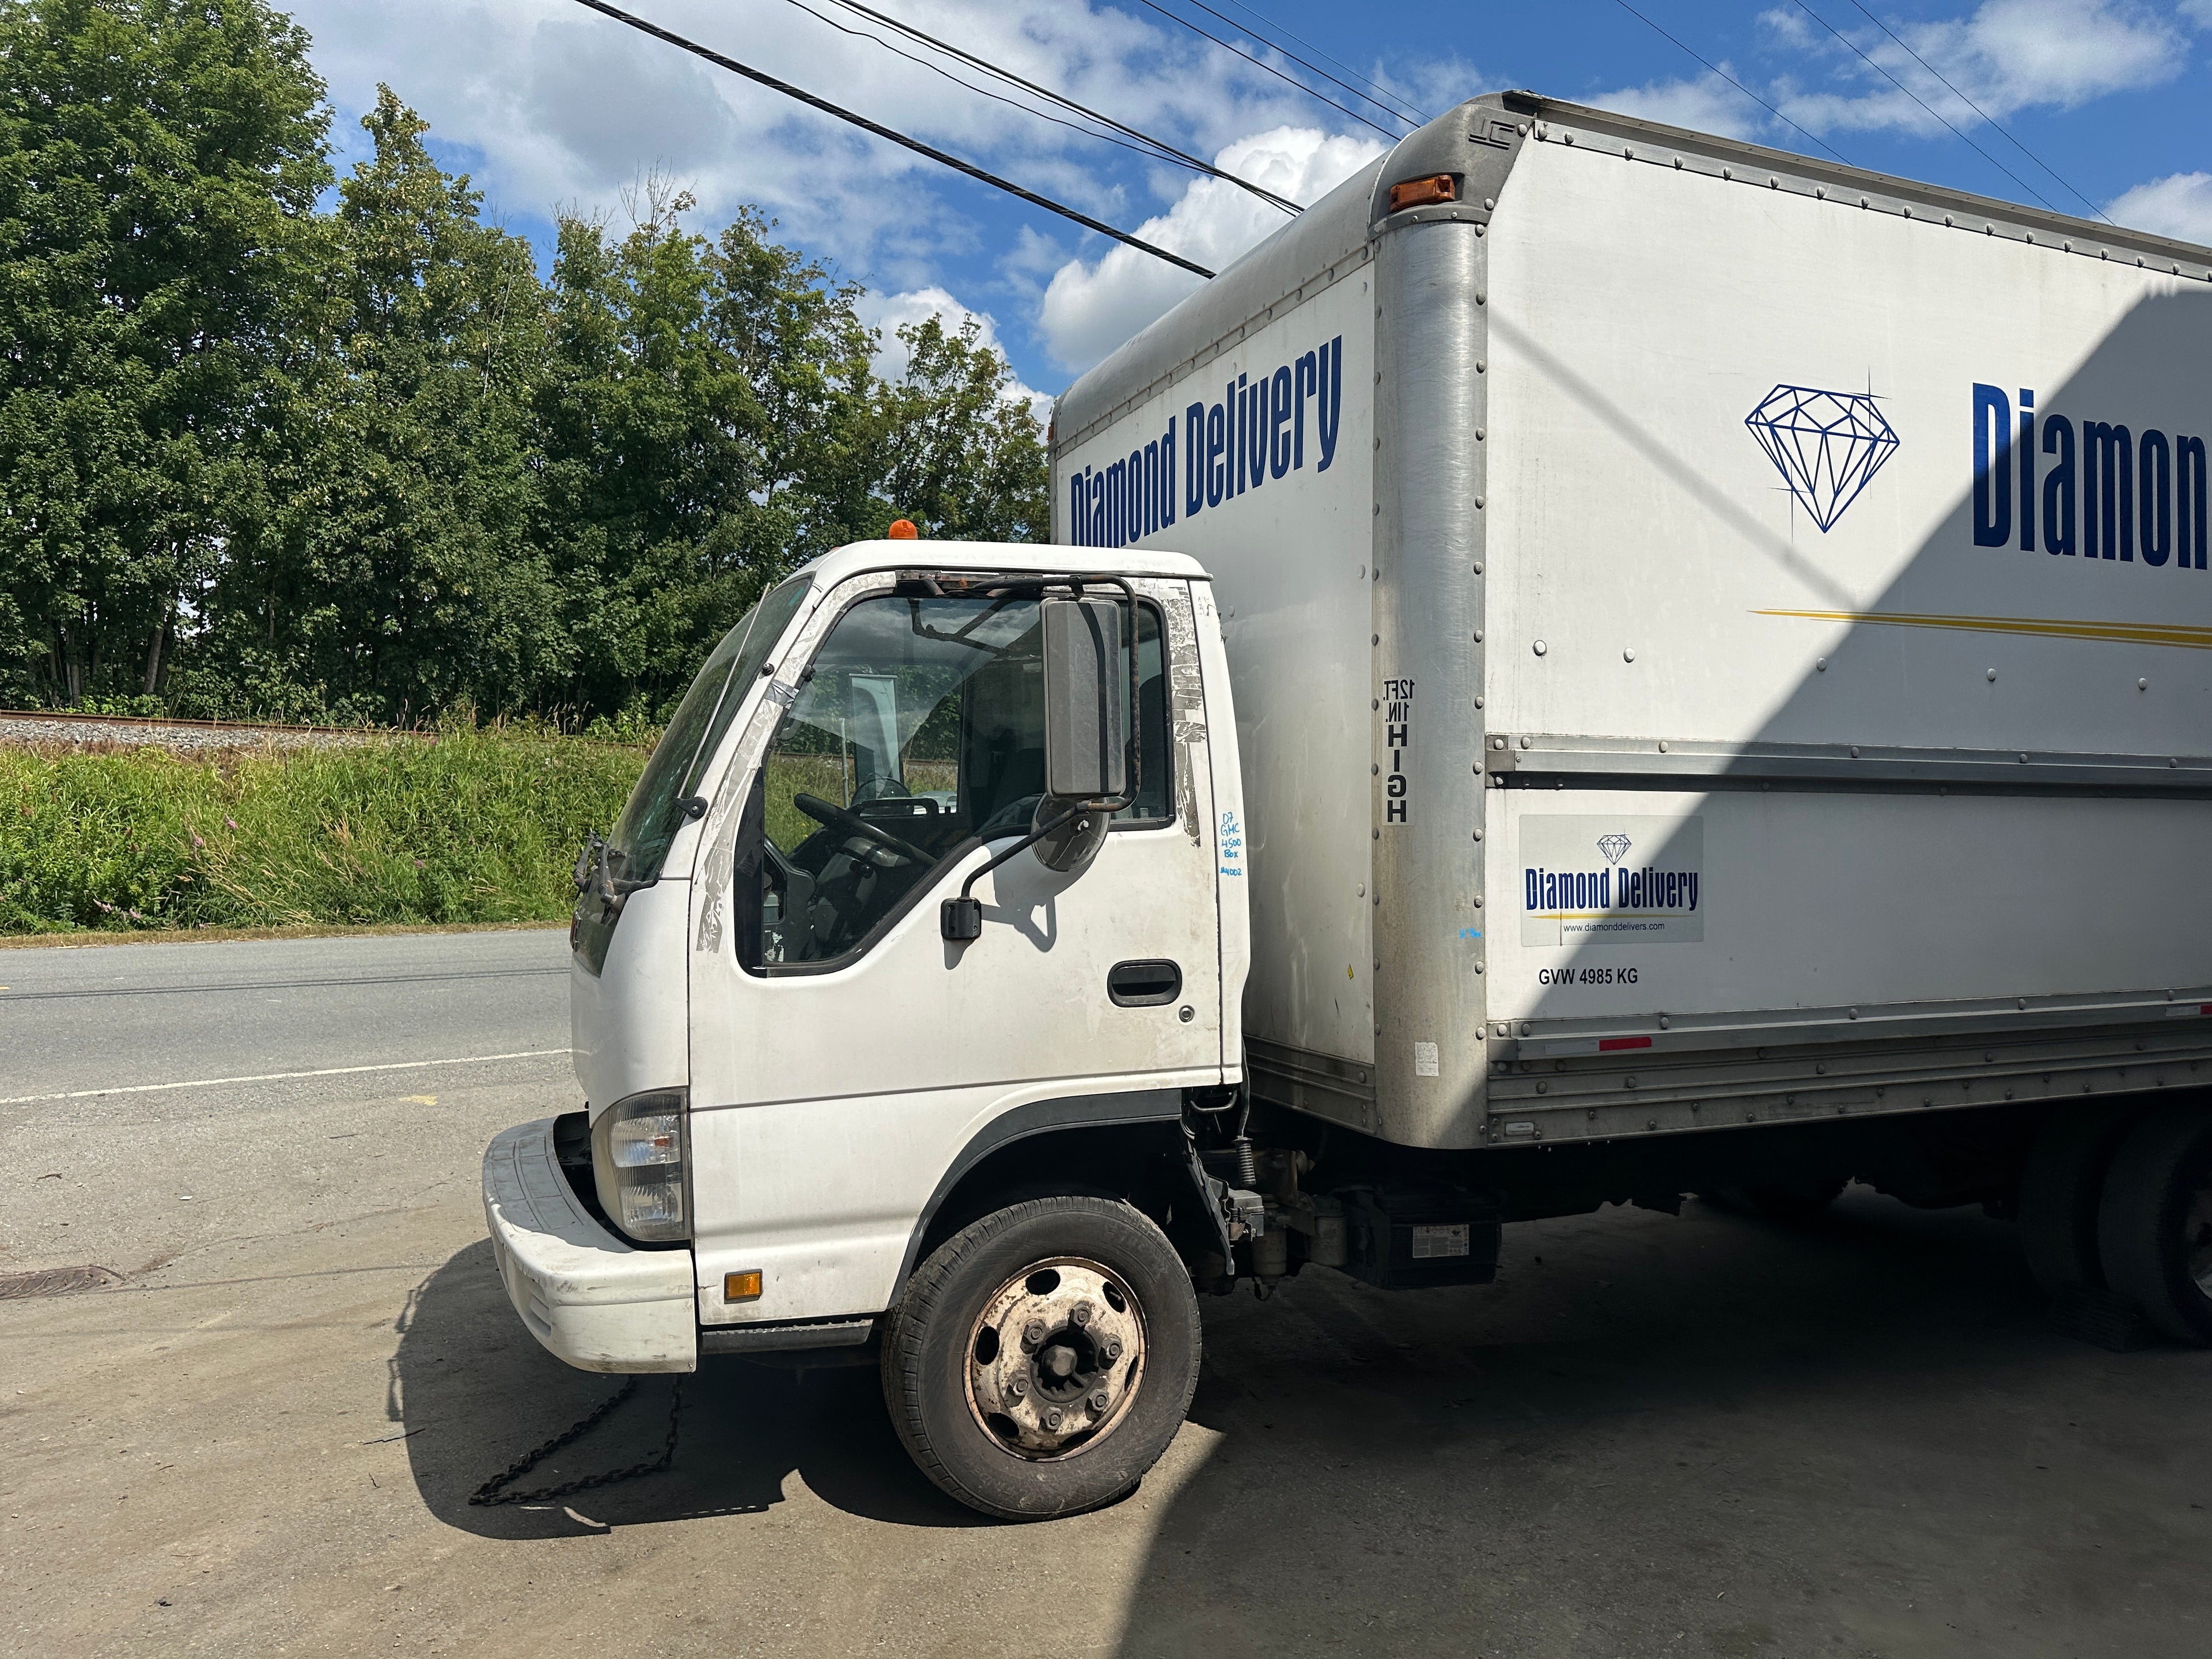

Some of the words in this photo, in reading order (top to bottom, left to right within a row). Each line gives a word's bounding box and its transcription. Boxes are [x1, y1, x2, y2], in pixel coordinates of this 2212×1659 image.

[1071, 415, 1176, 548] Diamond
[1185, 335, 1342, 518] Delivery
[1972, 382, 2208, 570] Diamon
[1221, 823, 1240, 836] GMC
[1221, 838, 1241, 849] 4500
[1525, 868, 1610, 910] Diamond
[1618, 866, 1698, 911] Delivery
[1563, 922, 1665, 933] www.diamonddelivers.com
[1539, 968, 1575, 984] GVW
[1579, 968, 1612, 984] 4985
[1617, 968, 1638, 983] KG
